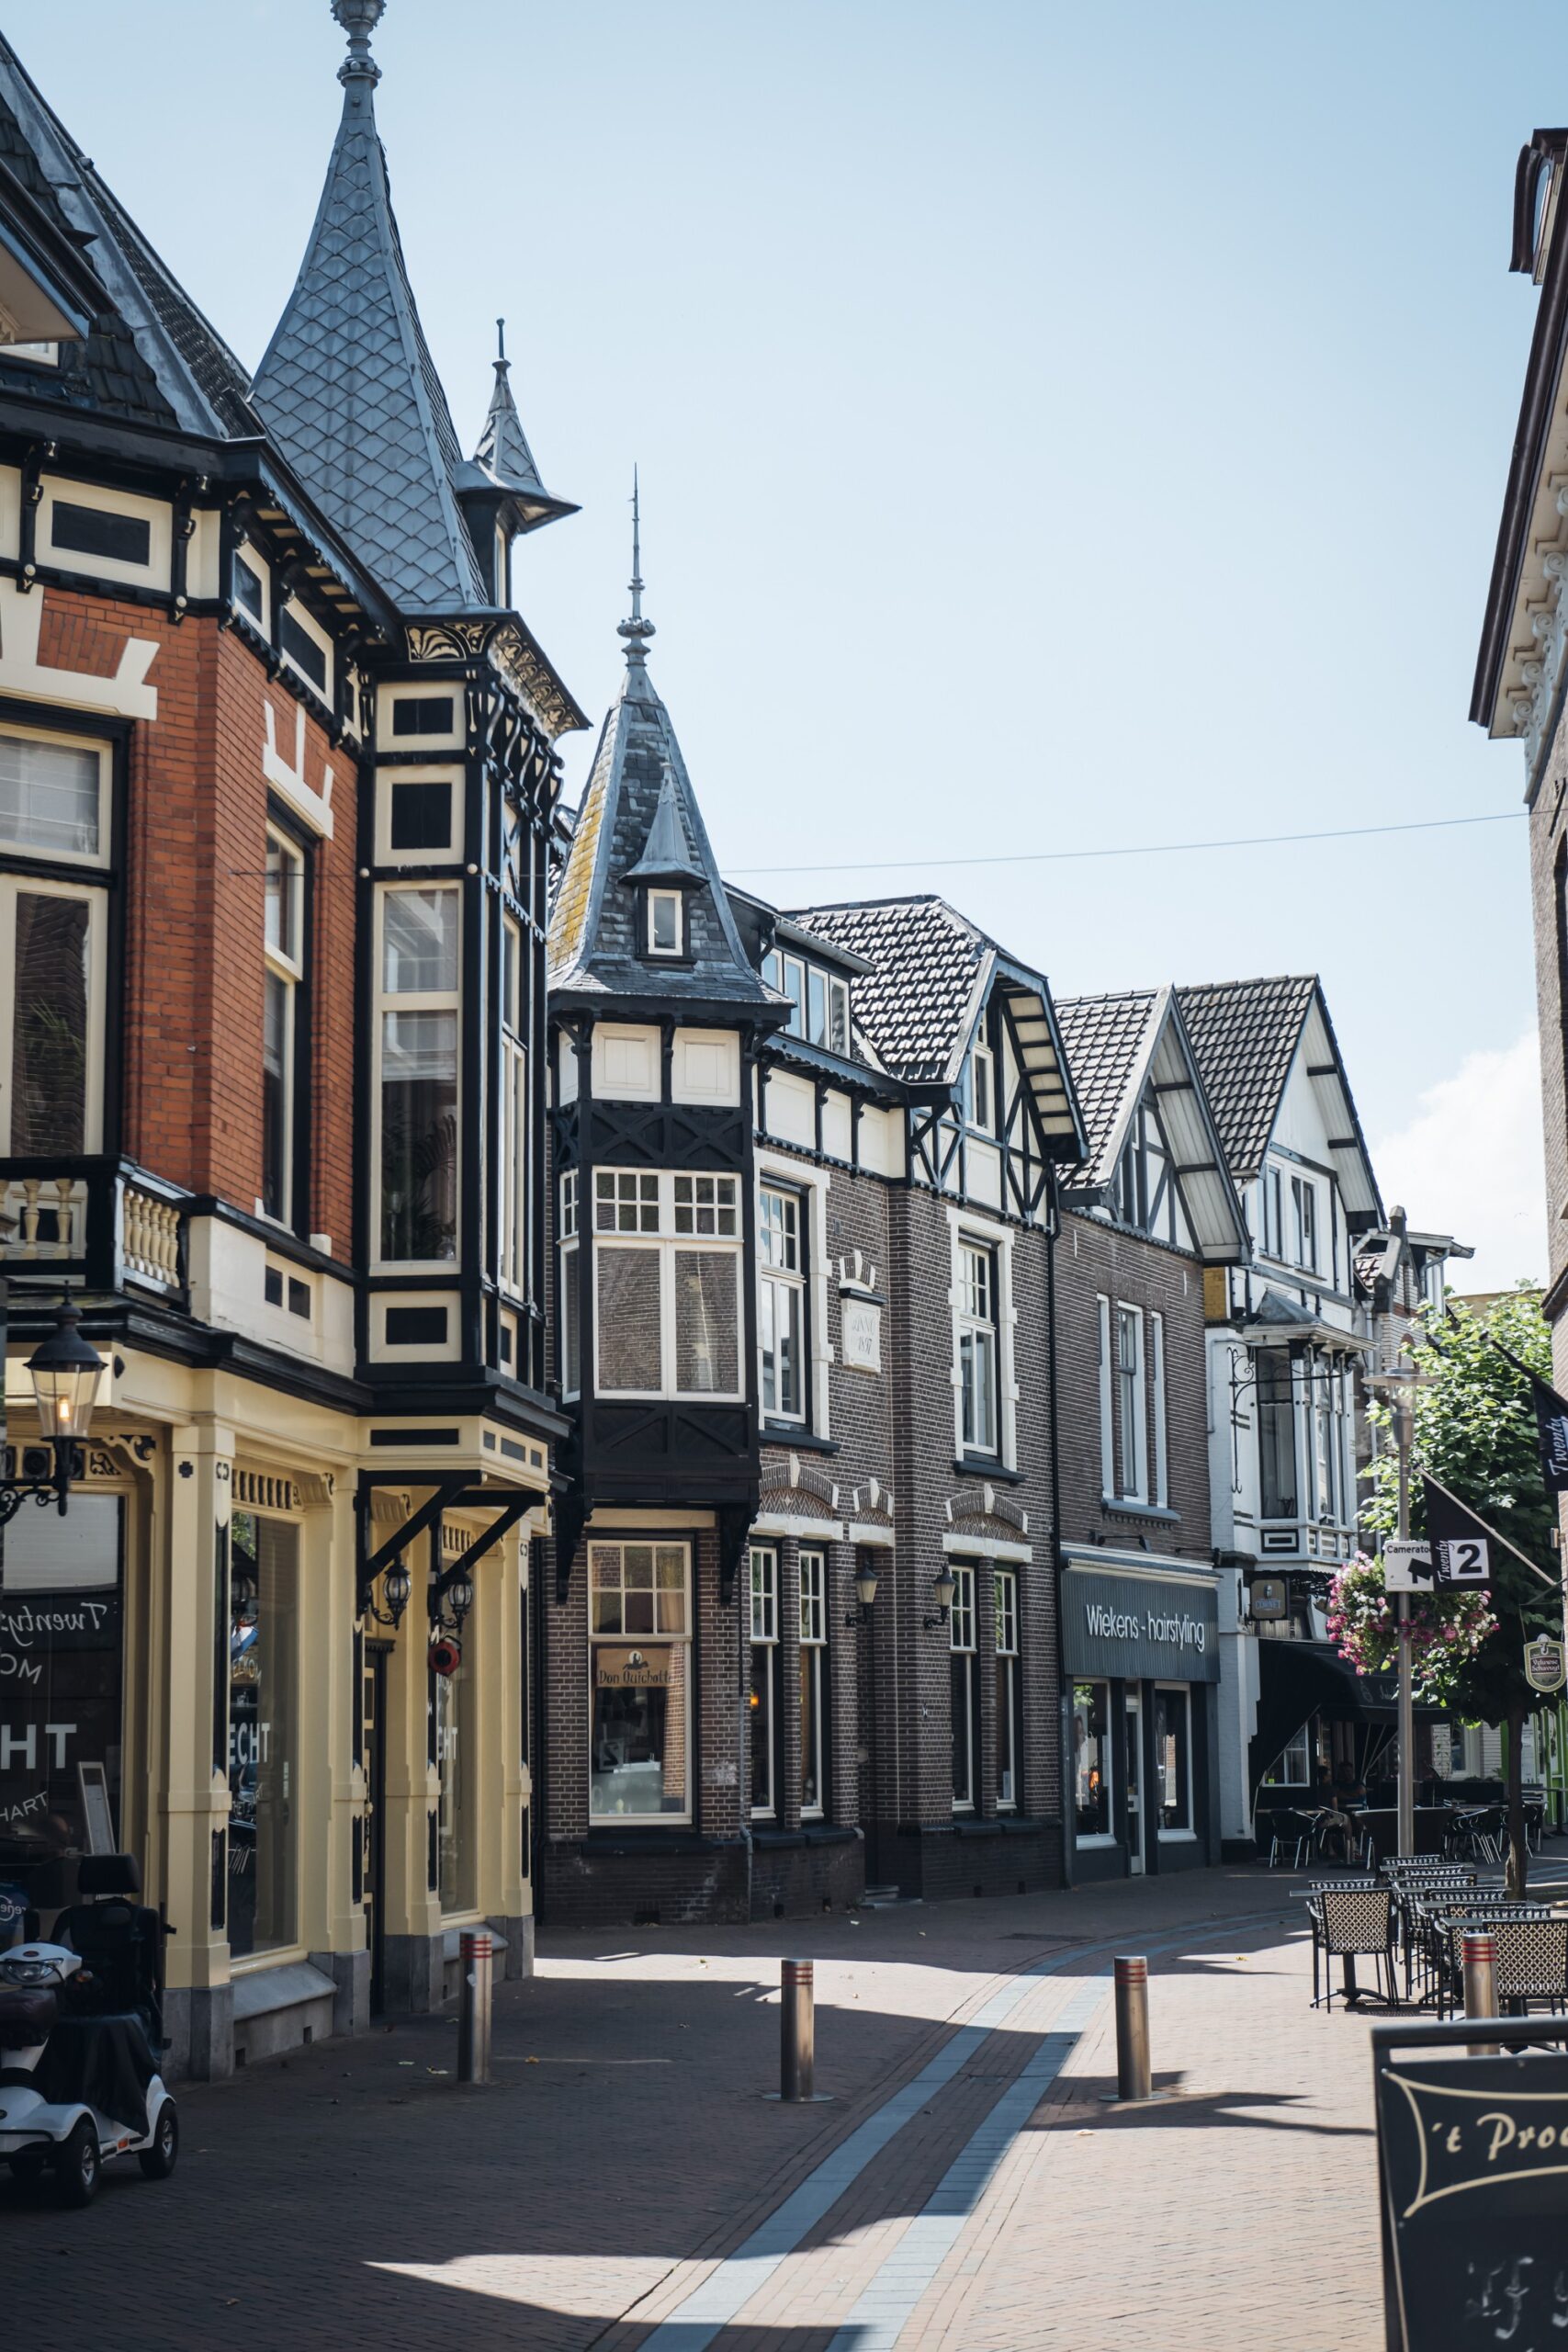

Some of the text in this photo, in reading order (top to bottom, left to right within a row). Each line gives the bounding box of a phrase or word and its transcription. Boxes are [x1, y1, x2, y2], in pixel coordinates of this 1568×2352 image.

[1435, 1540, 1483, 1582] Twenty 2
[1086, 1604, 1139, 1639] Wiekens
[1147, 1610, 1205, 1653] hairstyling
[599, 1670, 620, 1684] Don
[230, 1723, 271, 1765] ECHT
